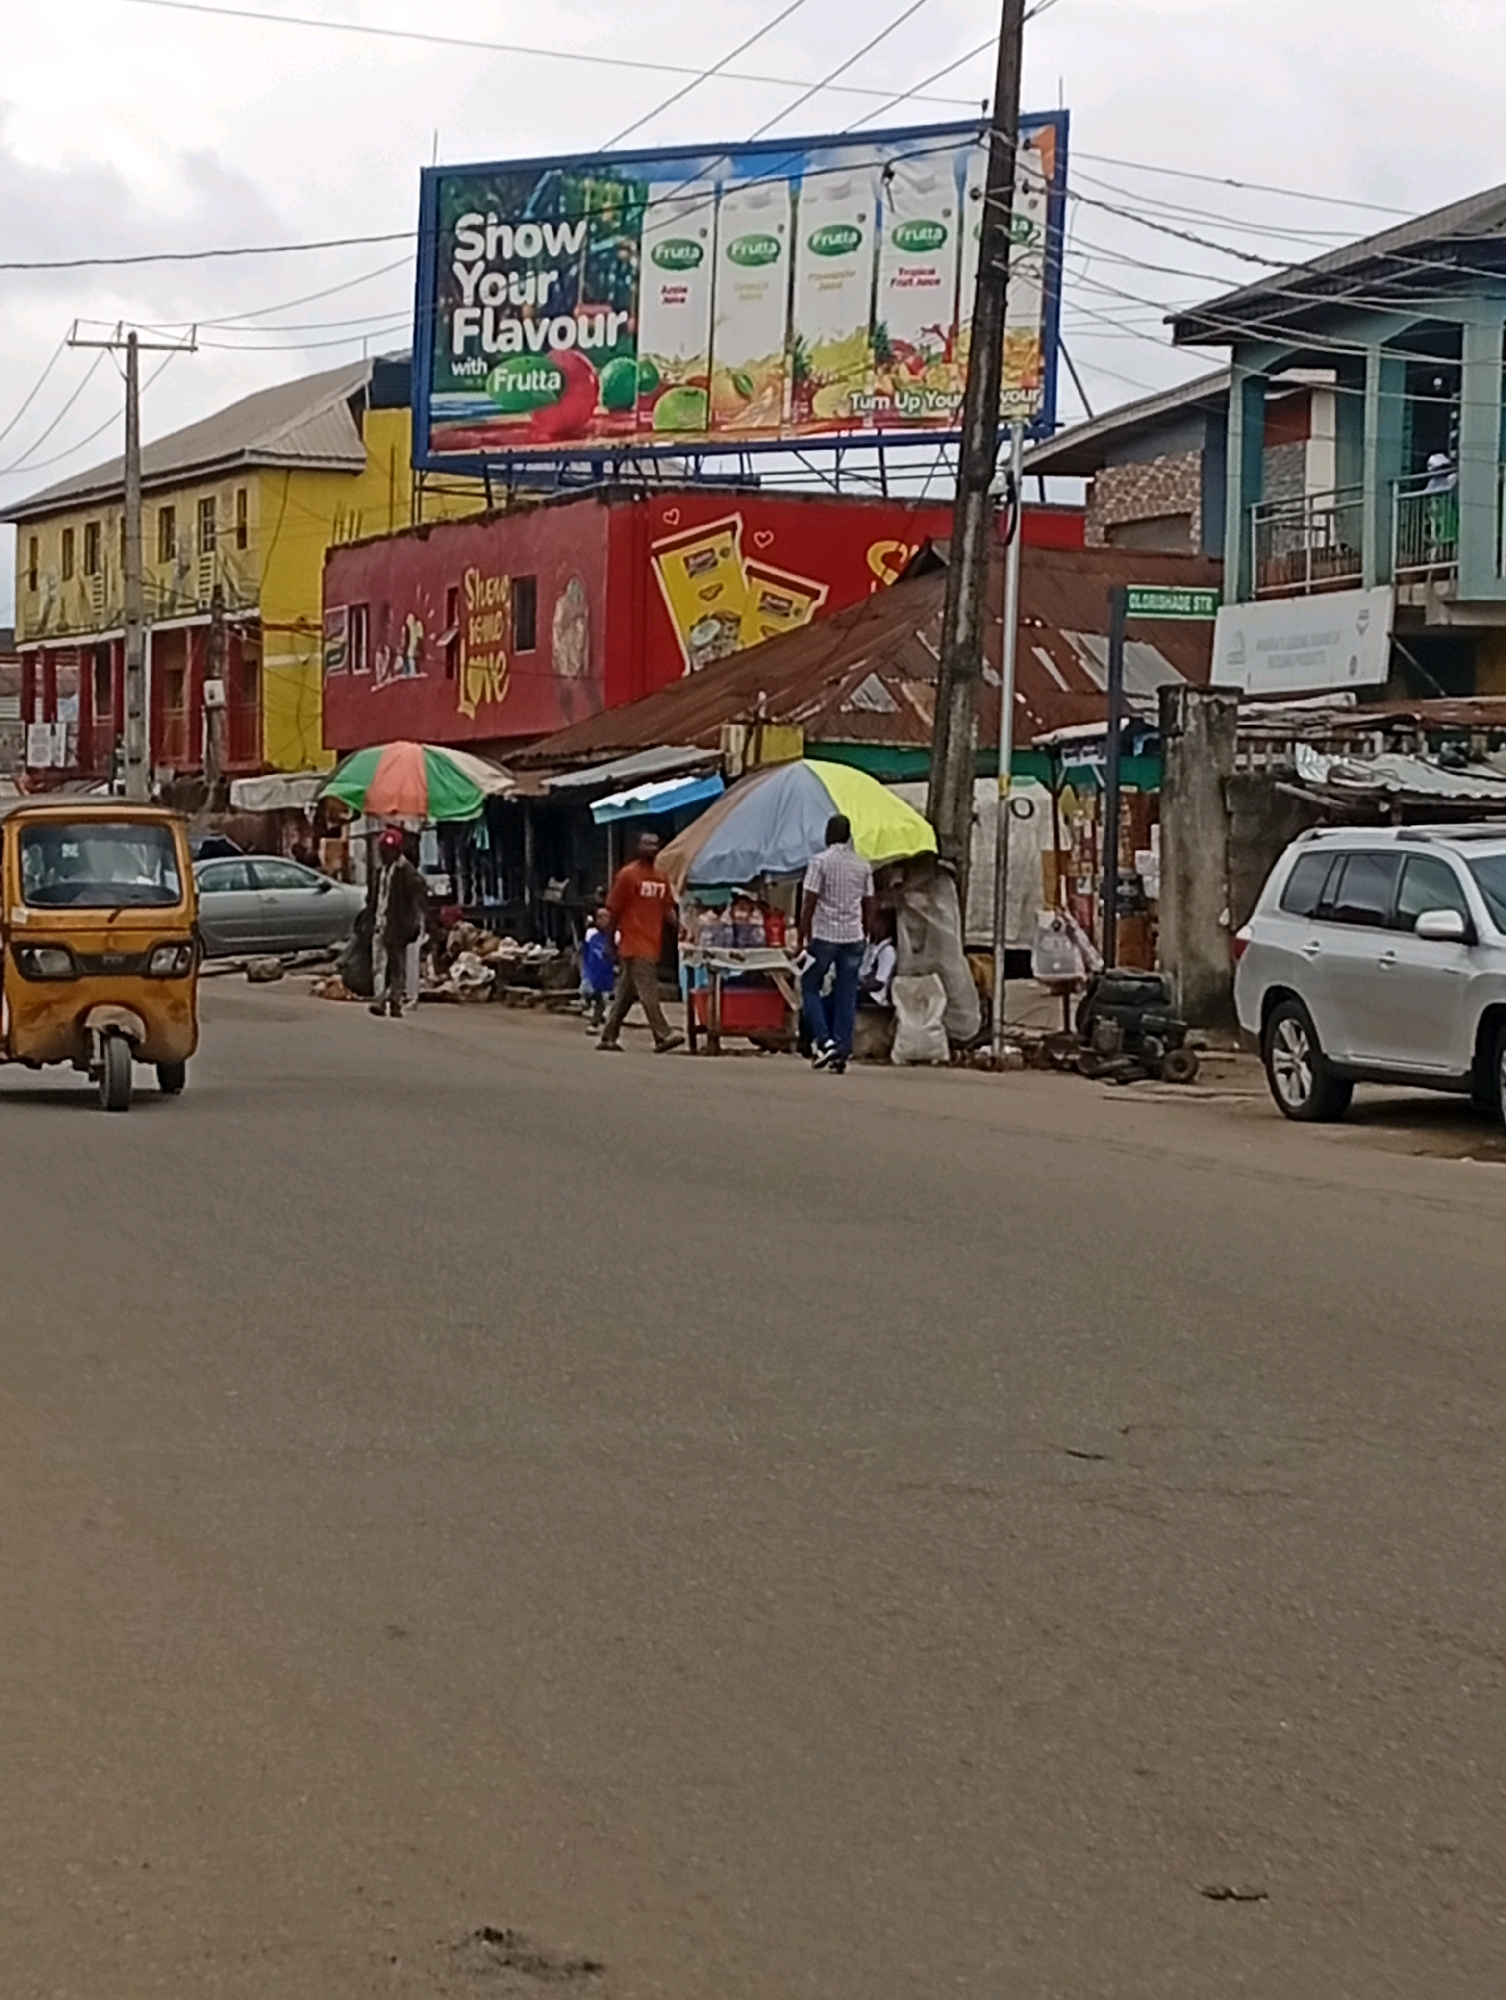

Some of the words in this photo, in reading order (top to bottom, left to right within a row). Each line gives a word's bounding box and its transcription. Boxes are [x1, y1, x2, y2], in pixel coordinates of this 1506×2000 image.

[454, 212, 587, 261] Show
[811, 231, 858, 247] Frutta
[896, 226, 943, 242] Frutta
[655, 244, 701, 261] Frutta
[731, 241, 778, 257] Frutta
[453, 260, 558, 306] Your
[452, 307, 628, 355] Flavour
[451, 357, 488, 376] with
[494, 367, 562, 392] Frutta
[850, 392, 890, 410] Turn
[894, 391, 921, 413] Up
[1193, 595, 1213, 611] STR
